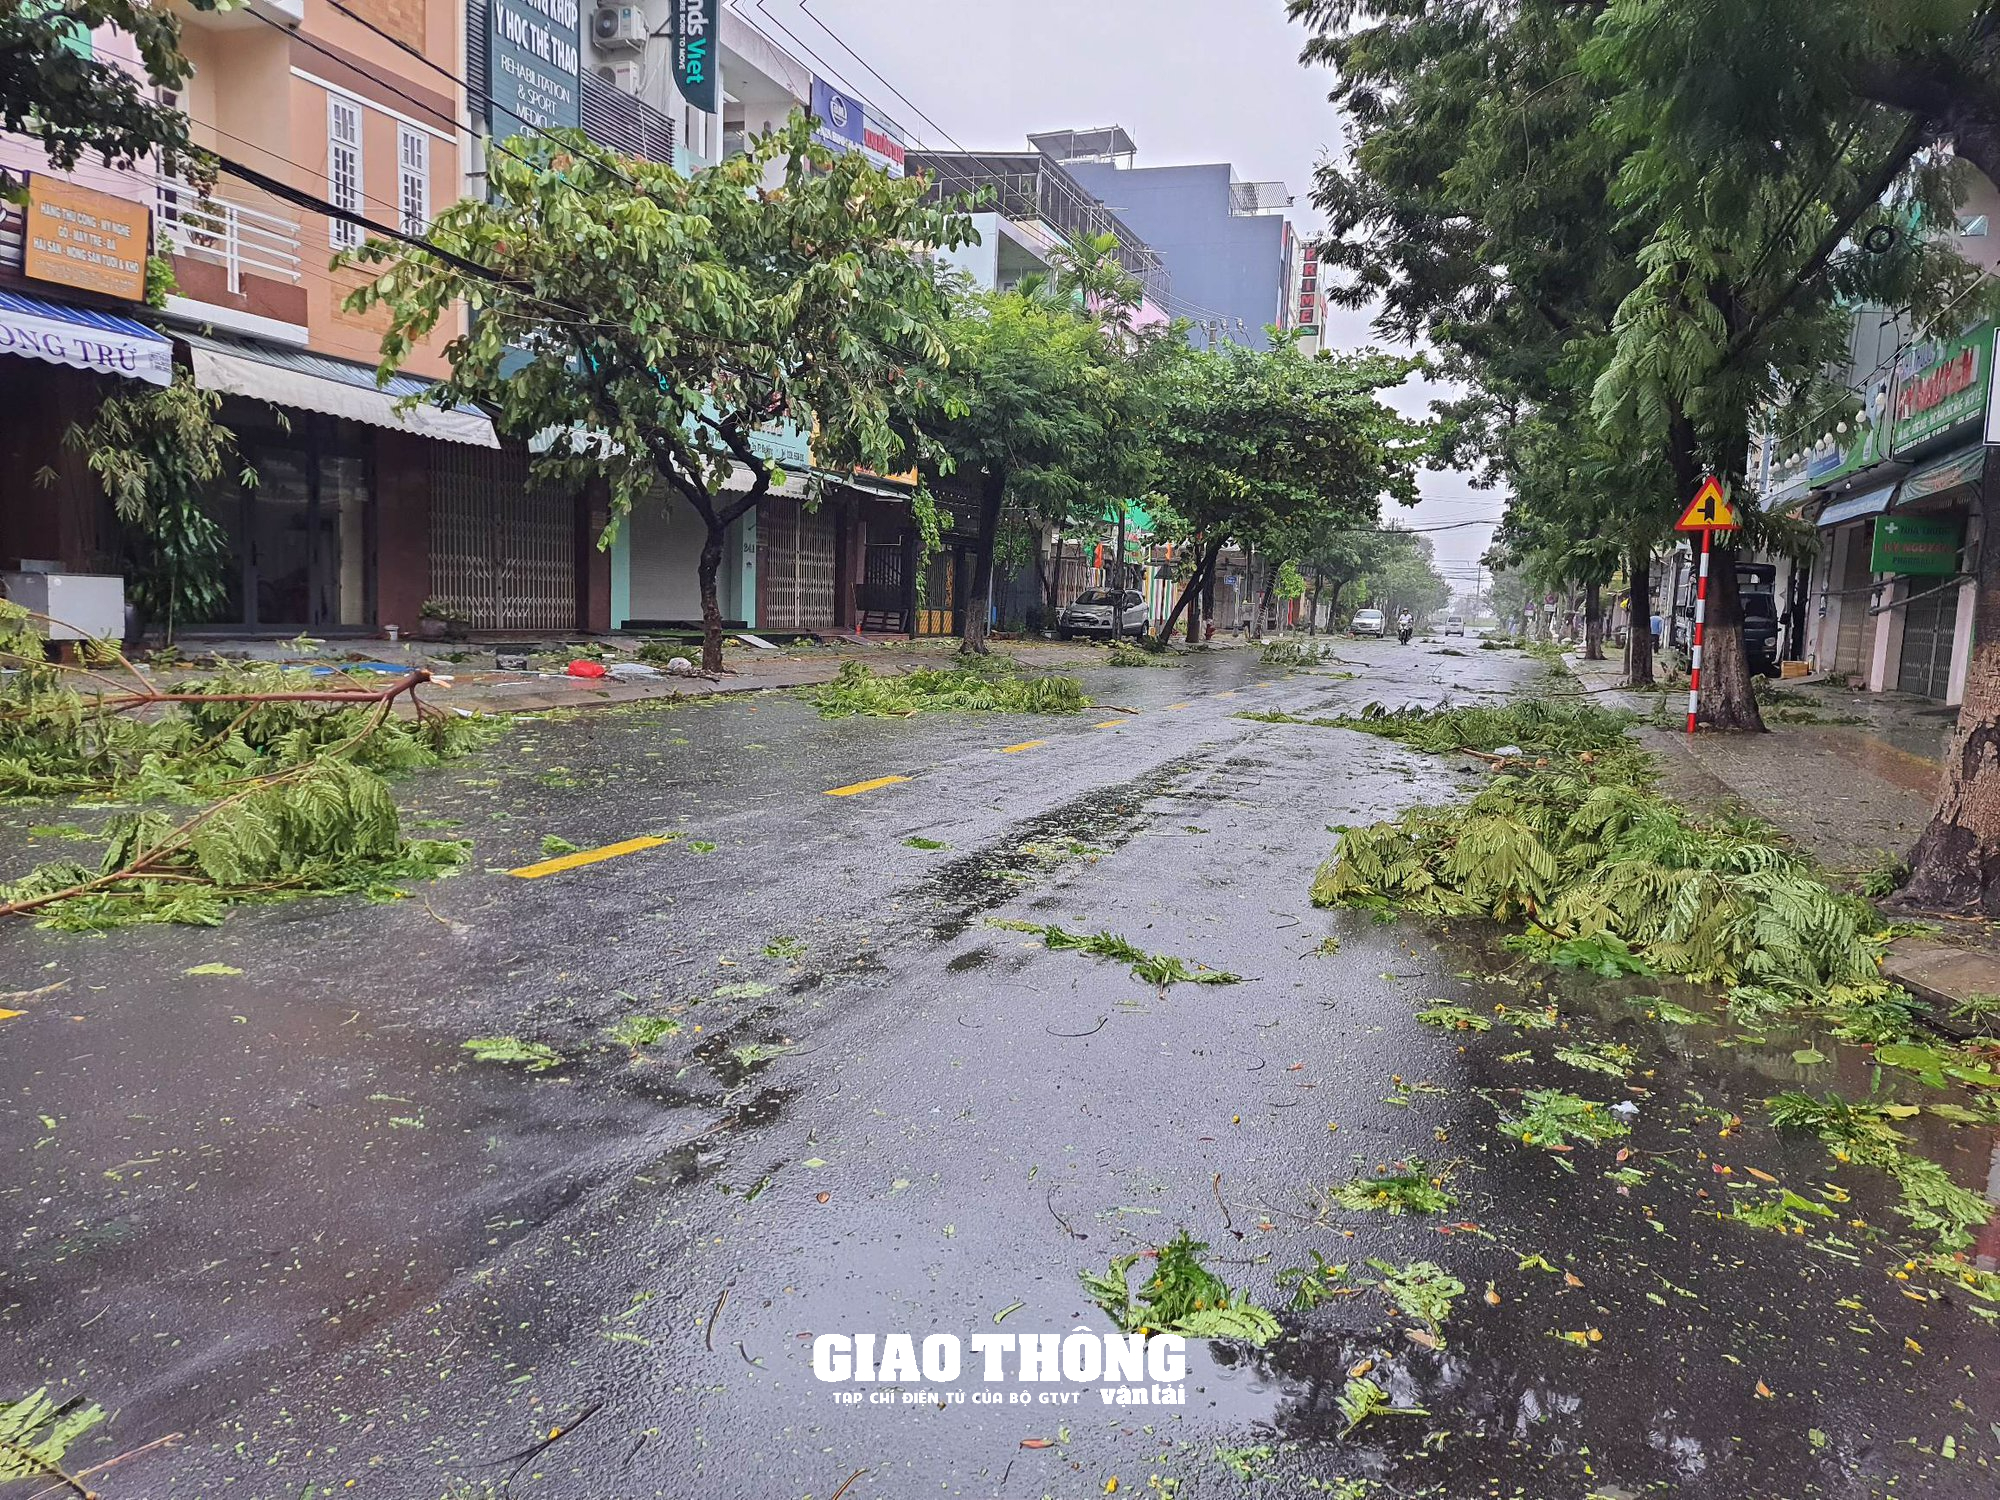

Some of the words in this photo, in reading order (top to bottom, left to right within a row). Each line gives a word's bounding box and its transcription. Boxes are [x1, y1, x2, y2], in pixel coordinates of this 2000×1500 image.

[506, 9, 529, 51] HỌC
[551, 36, 578, 77] THAO
[678, 48, 686, 70] MOVE
[679, 37, 686, 47] TO
[501, 54, 570, 104] REHABILITATION
[518, 84, 526, 100] &
[528, 89, 557, 115] SPORT
[1301, 248, 1317, 322] PRIME
